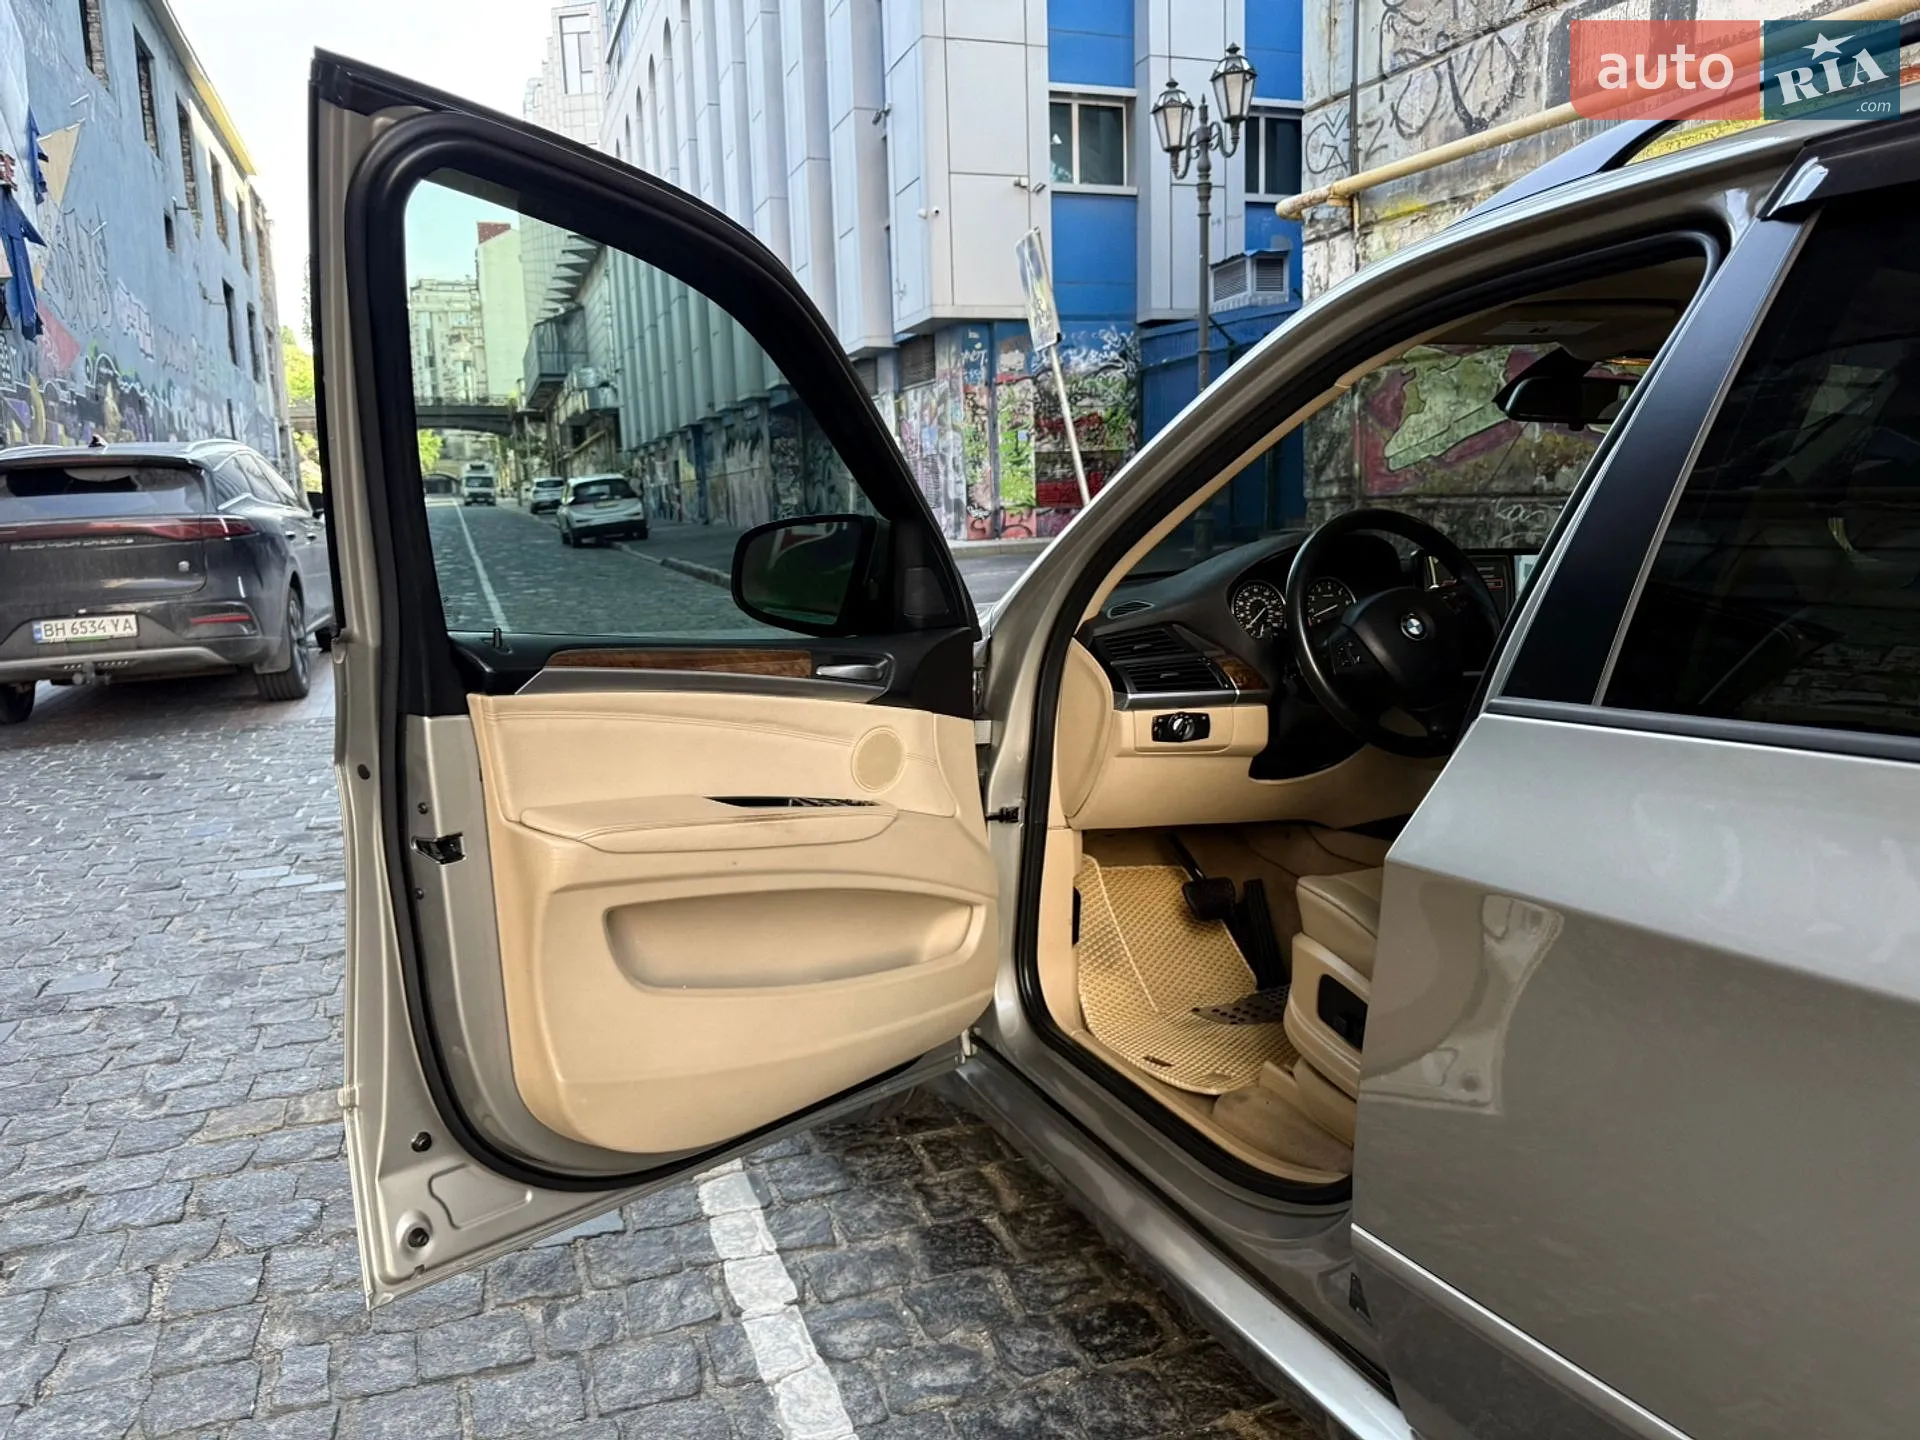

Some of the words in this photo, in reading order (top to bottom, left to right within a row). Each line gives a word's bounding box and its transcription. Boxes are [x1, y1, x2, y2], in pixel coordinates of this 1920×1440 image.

[43, 622, 66, 637] BH
[70, 619, 107, 635] 6534
[111, 618, 133, 632] YA
